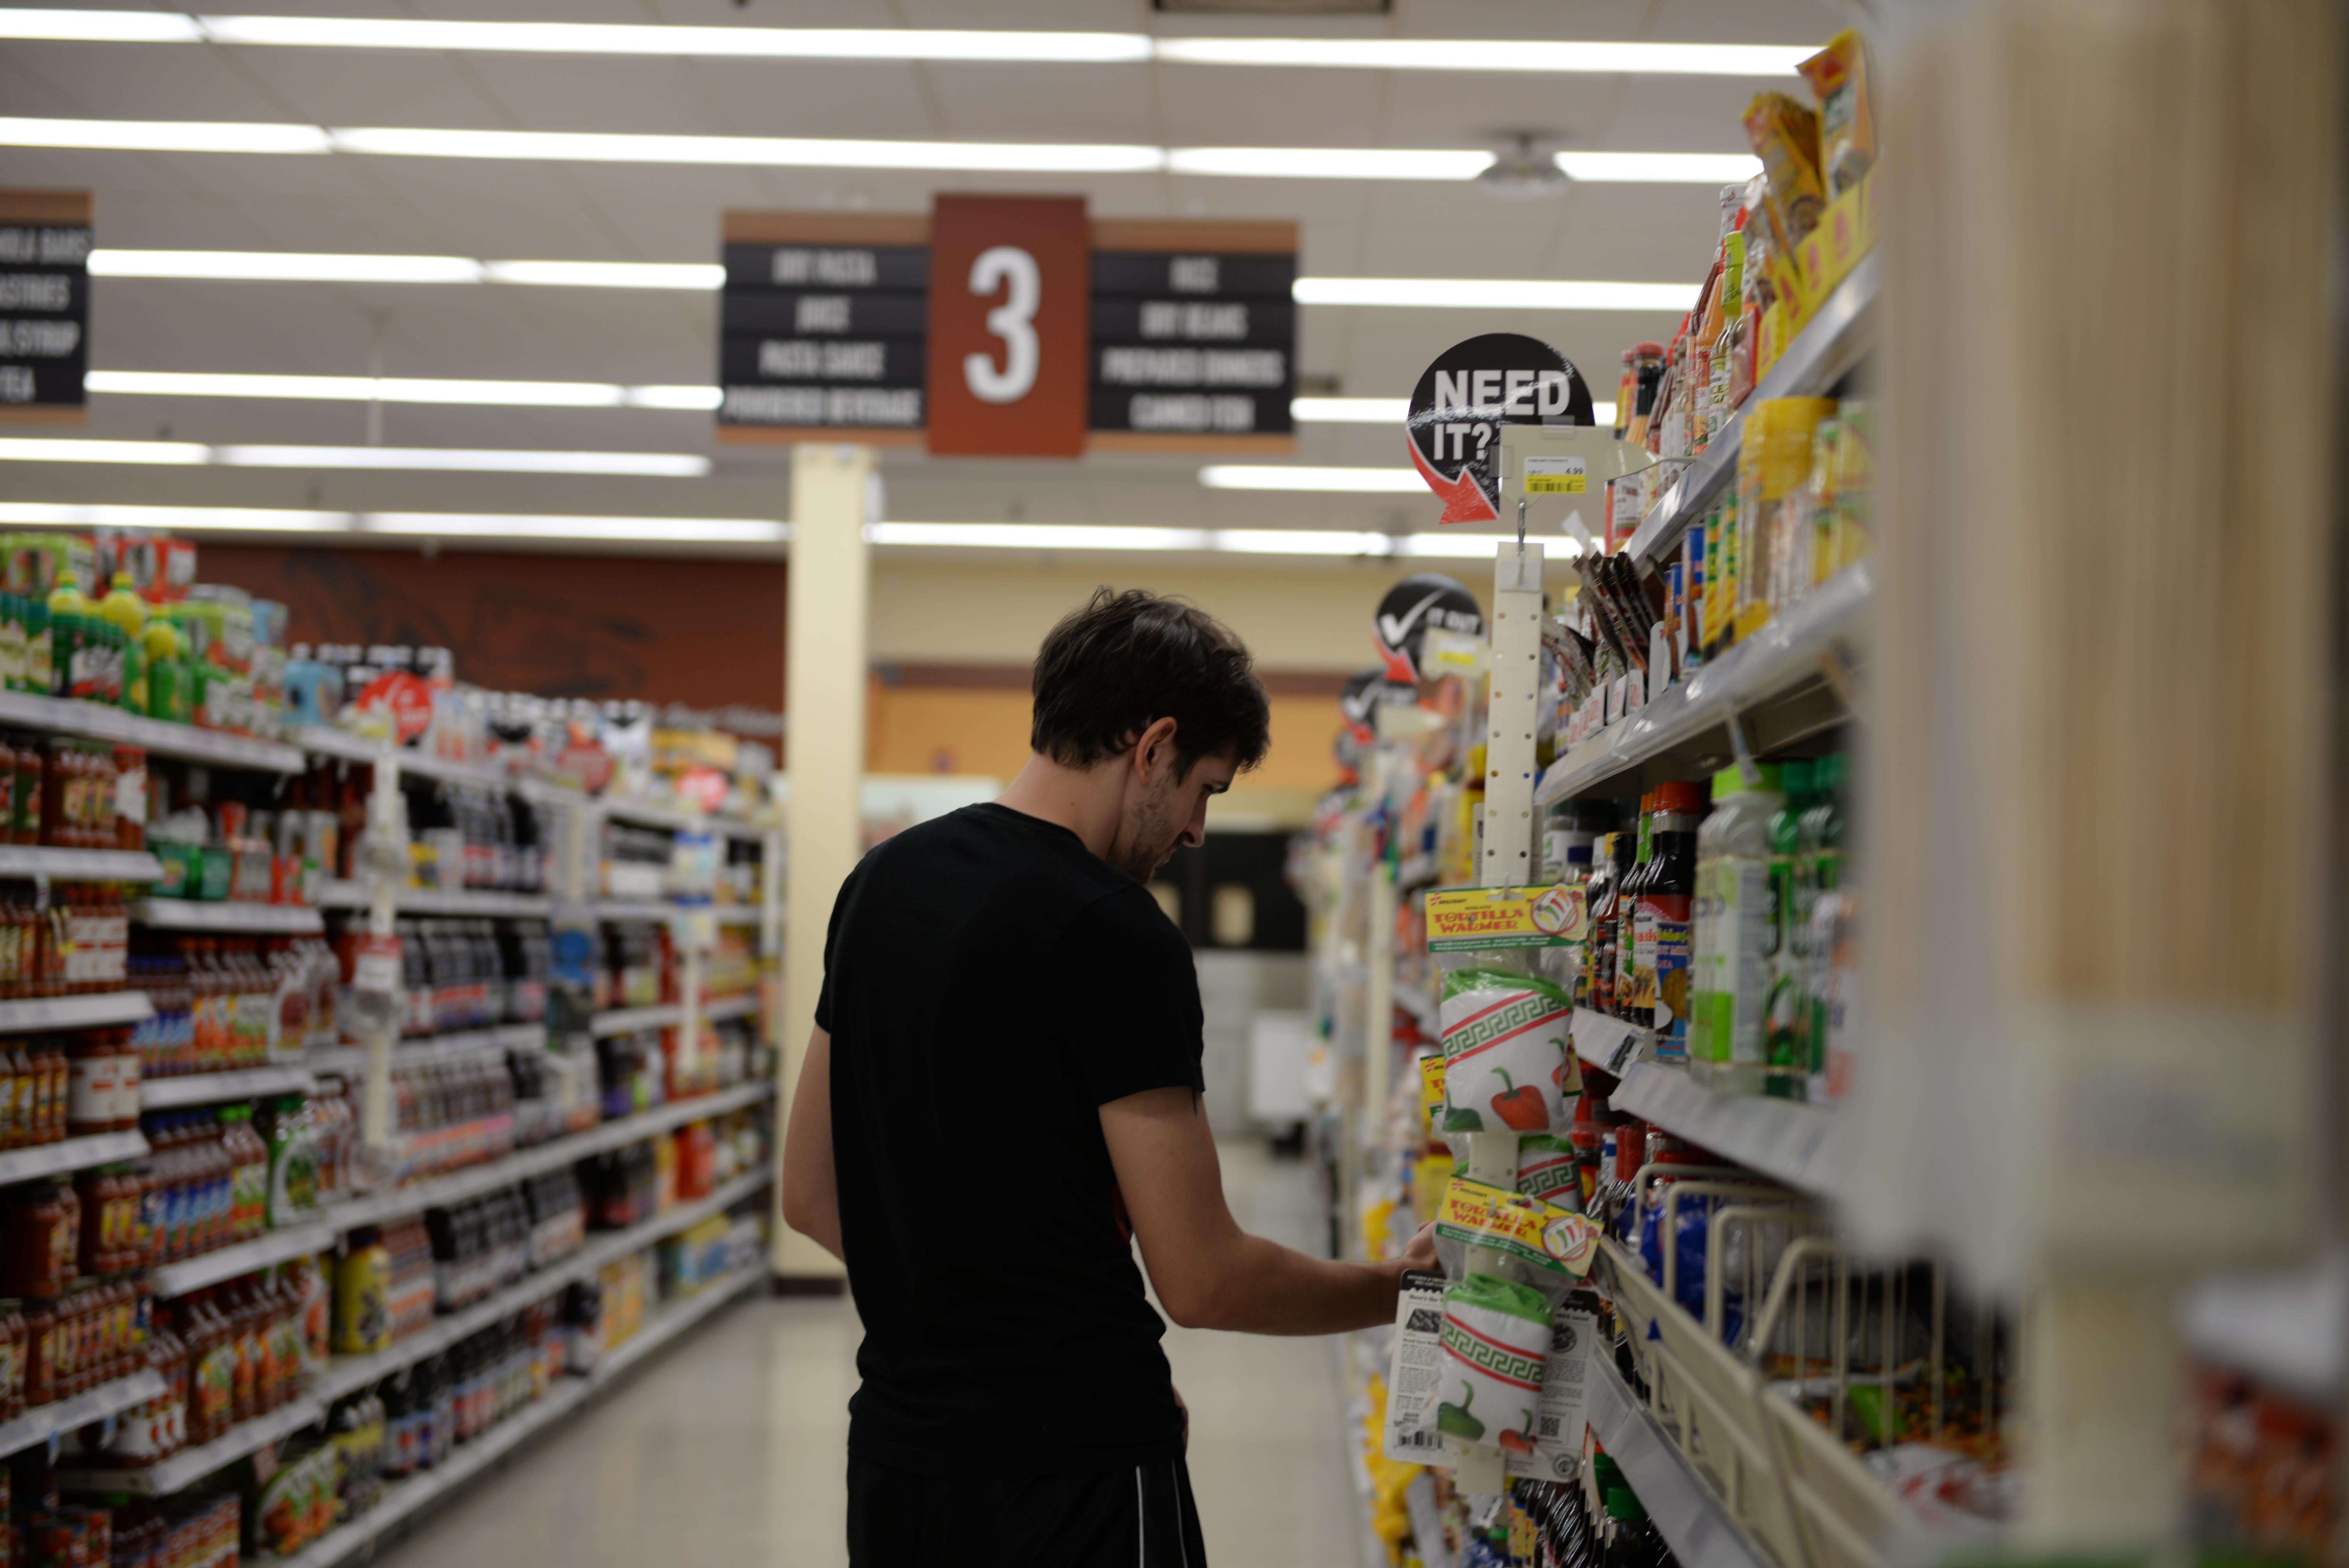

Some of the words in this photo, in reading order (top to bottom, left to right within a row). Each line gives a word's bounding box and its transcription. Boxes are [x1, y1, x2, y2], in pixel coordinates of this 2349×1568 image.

[964, 246, 1040, 403] 3
[1435, 370, 1570, 416] NEED
[1434, 422, 1492, 460] IT?
[1565, 467, 1584, 475] 4.99
[1433, 909, 1524, 923] TORTILLA
[1440, 920, 1518, 933] WARMER
[1453, 1210, 1527, 1238] WARMER
